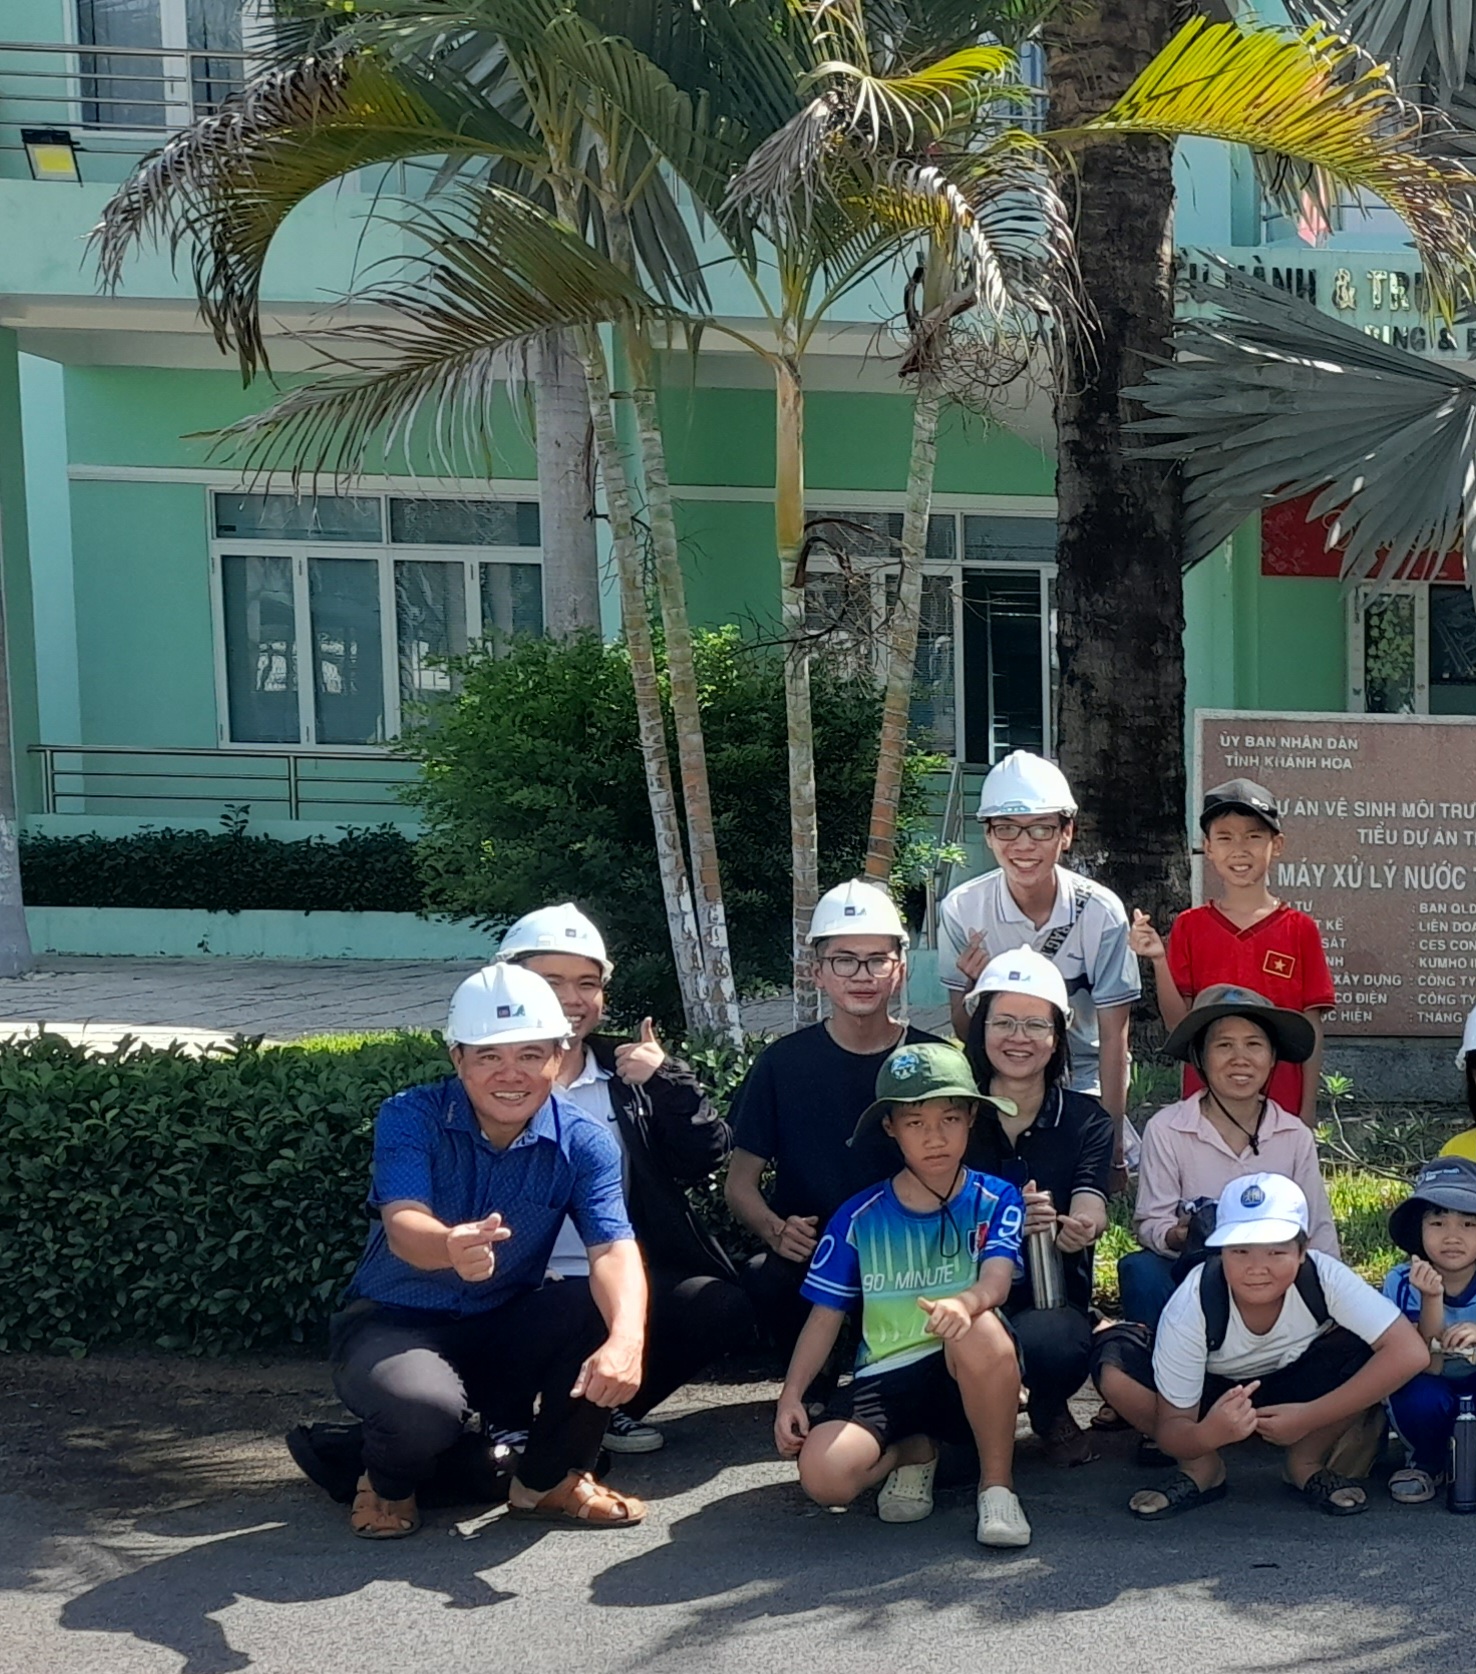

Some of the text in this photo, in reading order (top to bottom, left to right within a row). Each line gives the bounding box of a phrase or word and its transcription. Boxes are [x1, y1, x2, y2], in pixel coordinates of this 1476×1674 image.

[1225, 255, 1317, 306] ÀNH
[1332, 267, 1357, 311] &
[1438, 327, 1458, 350] &
[1244, 736, 1277, 749] BAN
[1280, 734, 1323, 750] NHÂN
[1327, 735, 1359, 751] DÂN
[1264, 753, 1318, 769] KHÁNH
[1276, 798, 1291, 819] Ự
[1294, 797, 1319, 817] ÁN
[1325, 797, 1348, 821] VỆ
[1353, 801, 1396, 818] SINH
[1401, 799, 1434, 819] MÔI
[1357, 820, 1399, 845] TIỂU
[1403, 827, 1430, 848] DỰ
[1433, 826, 1459, 846] ÁN
[1277, 857, 1326, 888] MÁY
[1332, 855, 1364, 889] XỬ
[1369, 859, 1397, 890] LÝ
[1404, 858, 1467, 891] NƯỚC
[1419, 902, 1447, 914] BAN
[1325, 915, 1345, 931] KẾ
[1419, 918, 1449, 933] LIÊN
[1321, 936, 1348, 949] SÁT
[1419, 939, 1447, 951] CES
[1419, 957, 1467, 969] KUMHO
[1333, 971, 1402, 988] XÂY DỰNG
[1417, 973, 1456, 987] CÔNG
[1460, 976, 1476, 987] TY
[1334, 990, 1388, 1006] CƠ ĐIỆN
[1417, 991, 1457, 1005] CÔNG
[1460, 994, 1476, 1005] TY
[1340, 1008, 1373, 1023] HIỆN
[1417, 1010, 1463, 1024] THÁNG
[862, 1264, 954, 1293] 90 MINUTE
